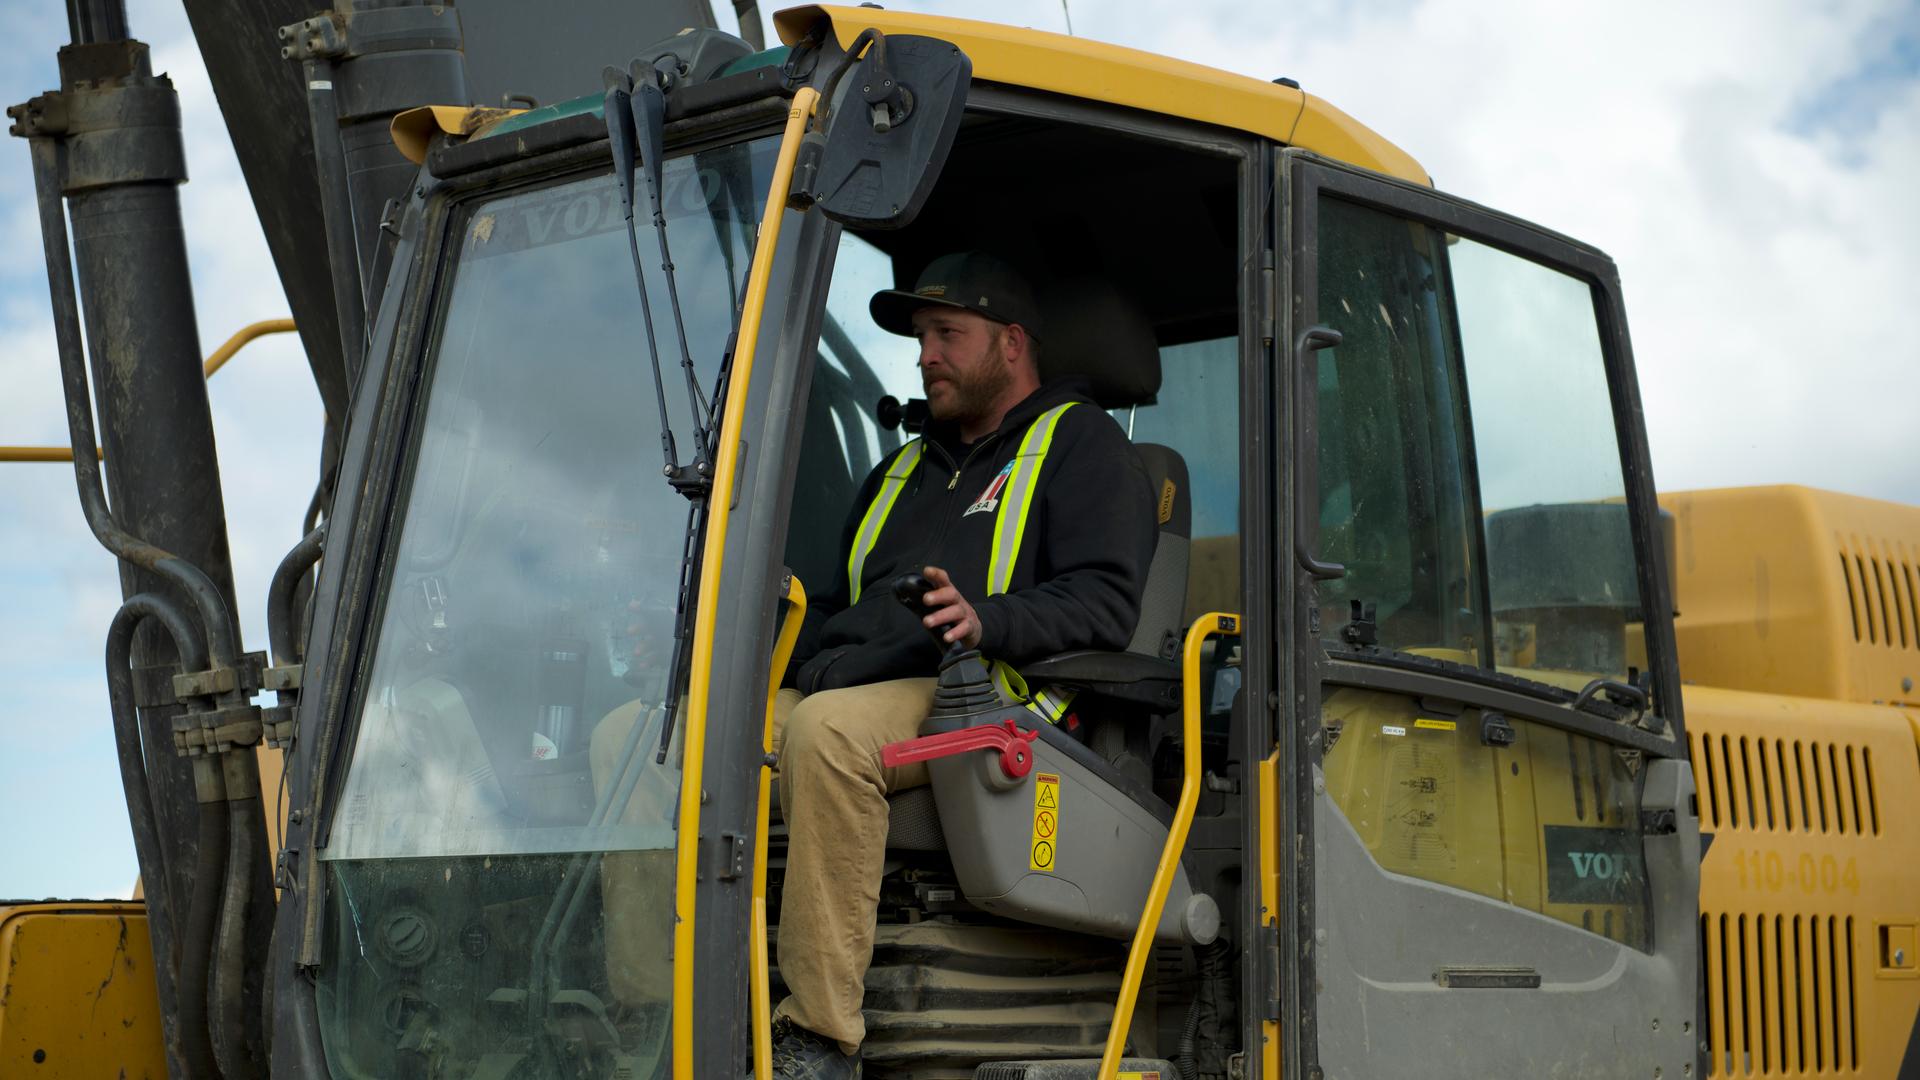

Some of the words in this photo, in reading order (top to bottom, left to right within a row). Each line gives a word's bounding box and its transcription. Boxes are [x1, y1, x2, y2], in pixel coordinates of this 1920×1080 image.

[967, 501, 990, 513] USA
[1161, 487, 1172, 517] VOLVO
[1733, 848, 1860, 896] 110-004
